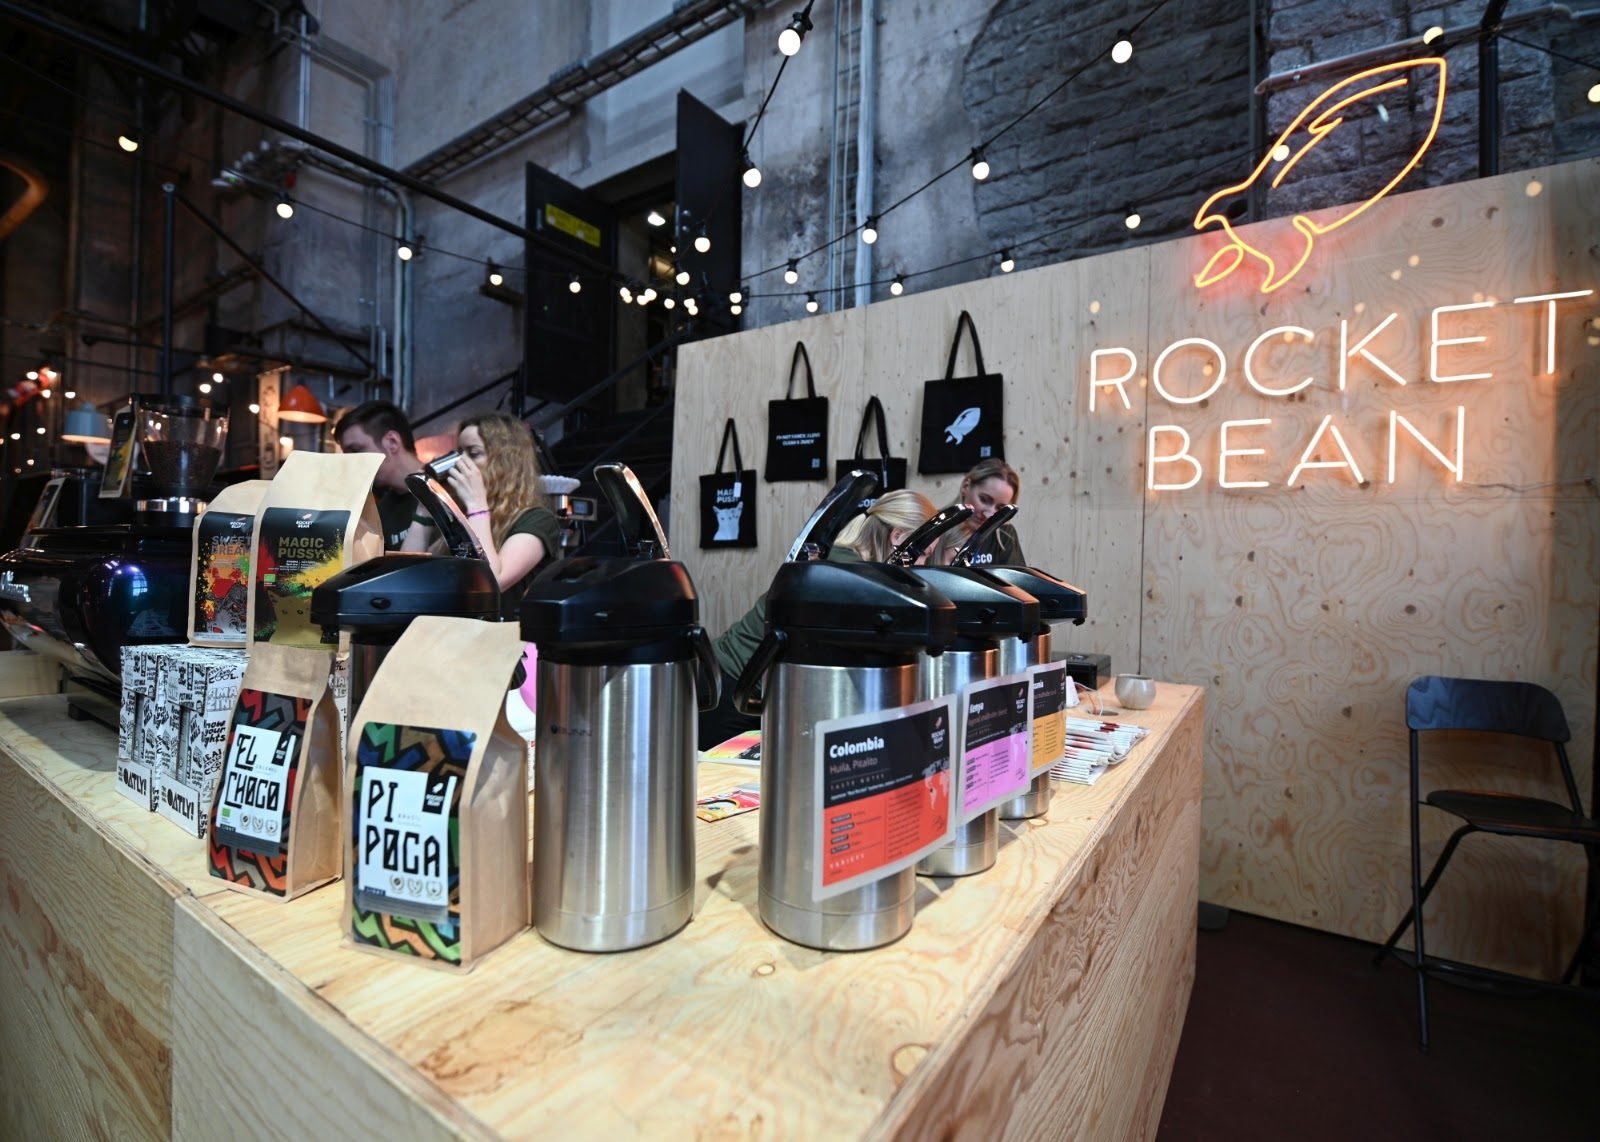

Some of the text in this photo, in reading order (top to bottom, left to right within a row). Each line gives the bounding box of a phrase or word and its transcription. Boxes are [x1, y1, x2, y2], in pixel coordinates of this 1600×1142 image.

[1090, 289, 1594, 413] ROCKET
[1147, 405, 1465, 491] BEAN
[278, 547, 325, 559] PUSSY
[279, 536, 324, 548] MAGIC
[234, 733, 257, 772] EL
[829, 736, 885, 759] Colombia
[123, 768, 147, 796] OATLY!
[167, 788, 195, 821] OATLY!
[367, 779, 398, 822] PI
